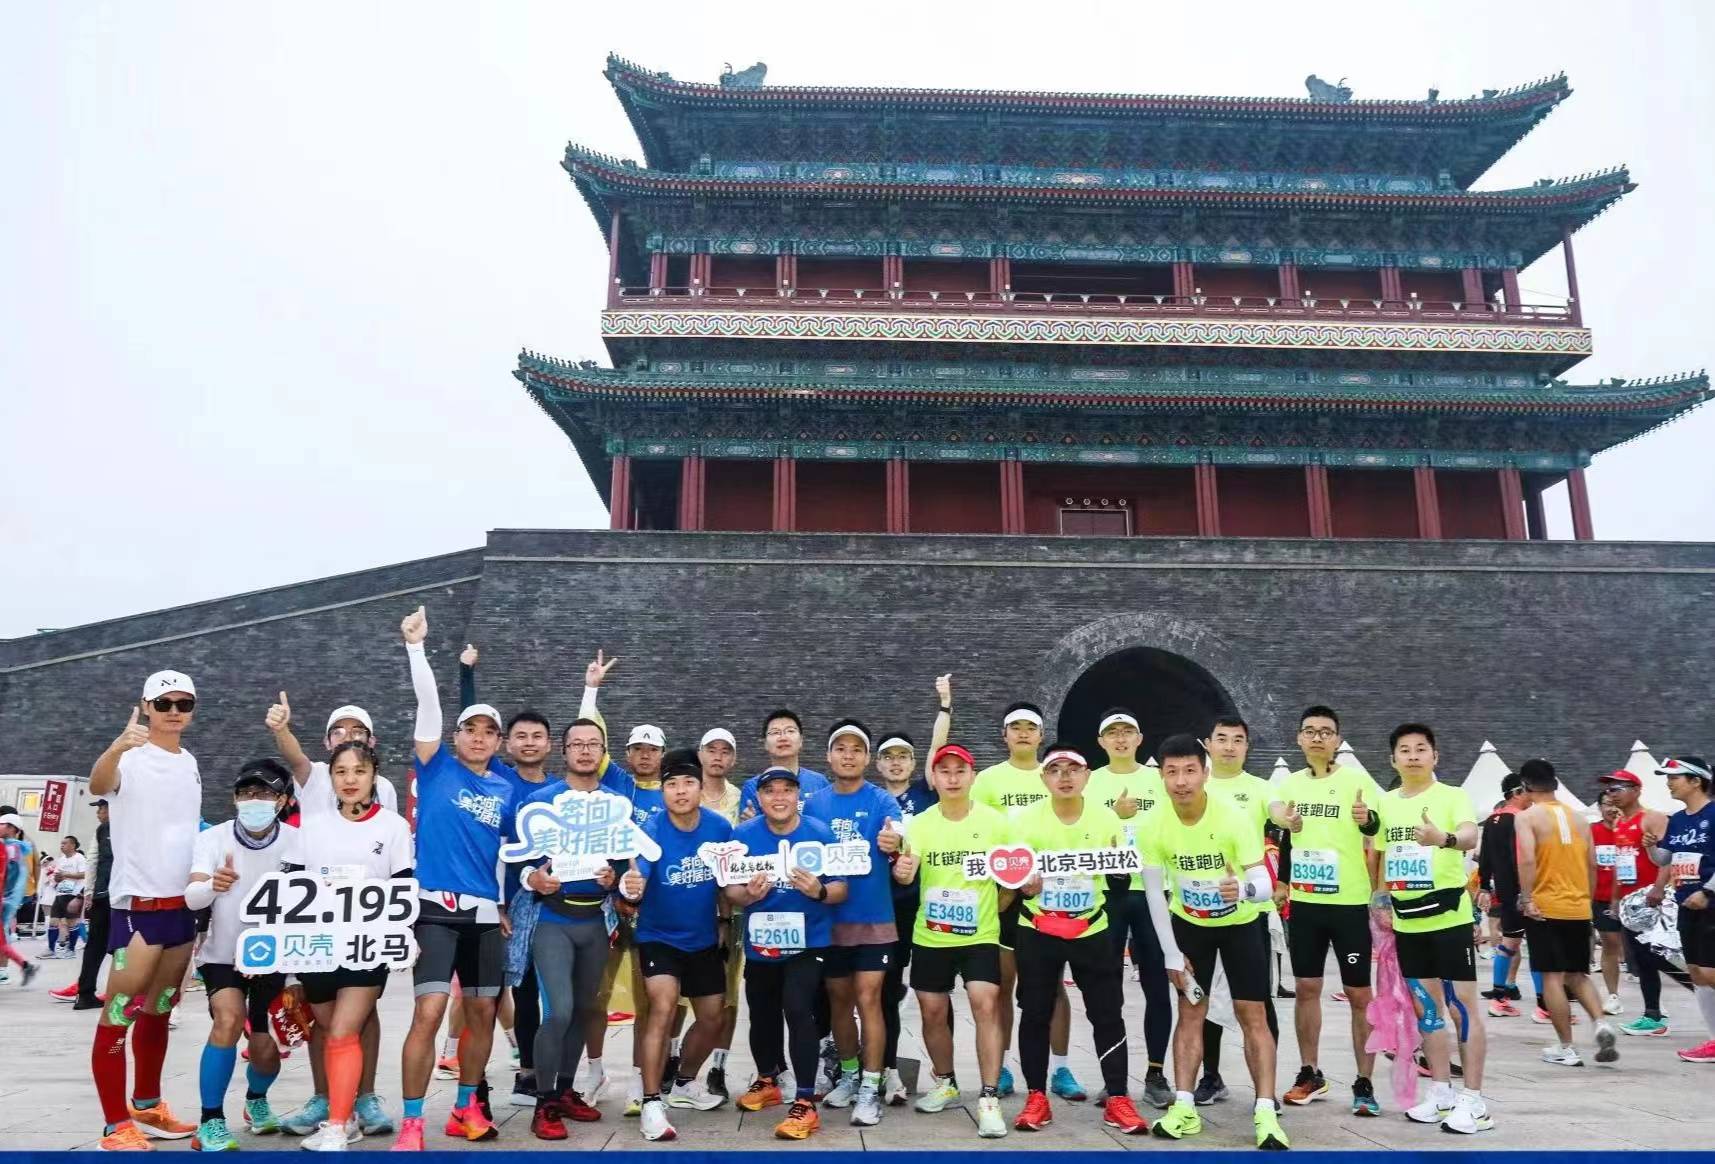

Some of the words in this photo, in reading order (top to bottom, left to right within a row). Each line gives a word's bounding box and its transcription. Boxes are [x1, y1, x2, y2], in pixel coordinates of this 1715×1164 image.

[1001, 793, 1049, 807] 北链跑
[560, 797, 611, 825] 奔向
[533, 825, 635, 855] 美好居住
[827, 845, 867, 863] 贝壳
[967, 858, 986, 877] 我
[1037, 850, 1138, 873] 北京马拉松
[1167, 851, 1226, 872] 链跑团
[1293, 863, 1335, 880] B3942
[1387, 859, 1428, 877] F1946
[246, 877, 413, 925] 42.195
[1043, 891, 1091, 908] F1807
[1183, 889, 1222, 907] F364
[928, 902, 974, 922] E3498
[754, 928, 800, 945] F2610
[284, 934, 333, 957] 贝壳
[346, 933, 409, 963] 北马
